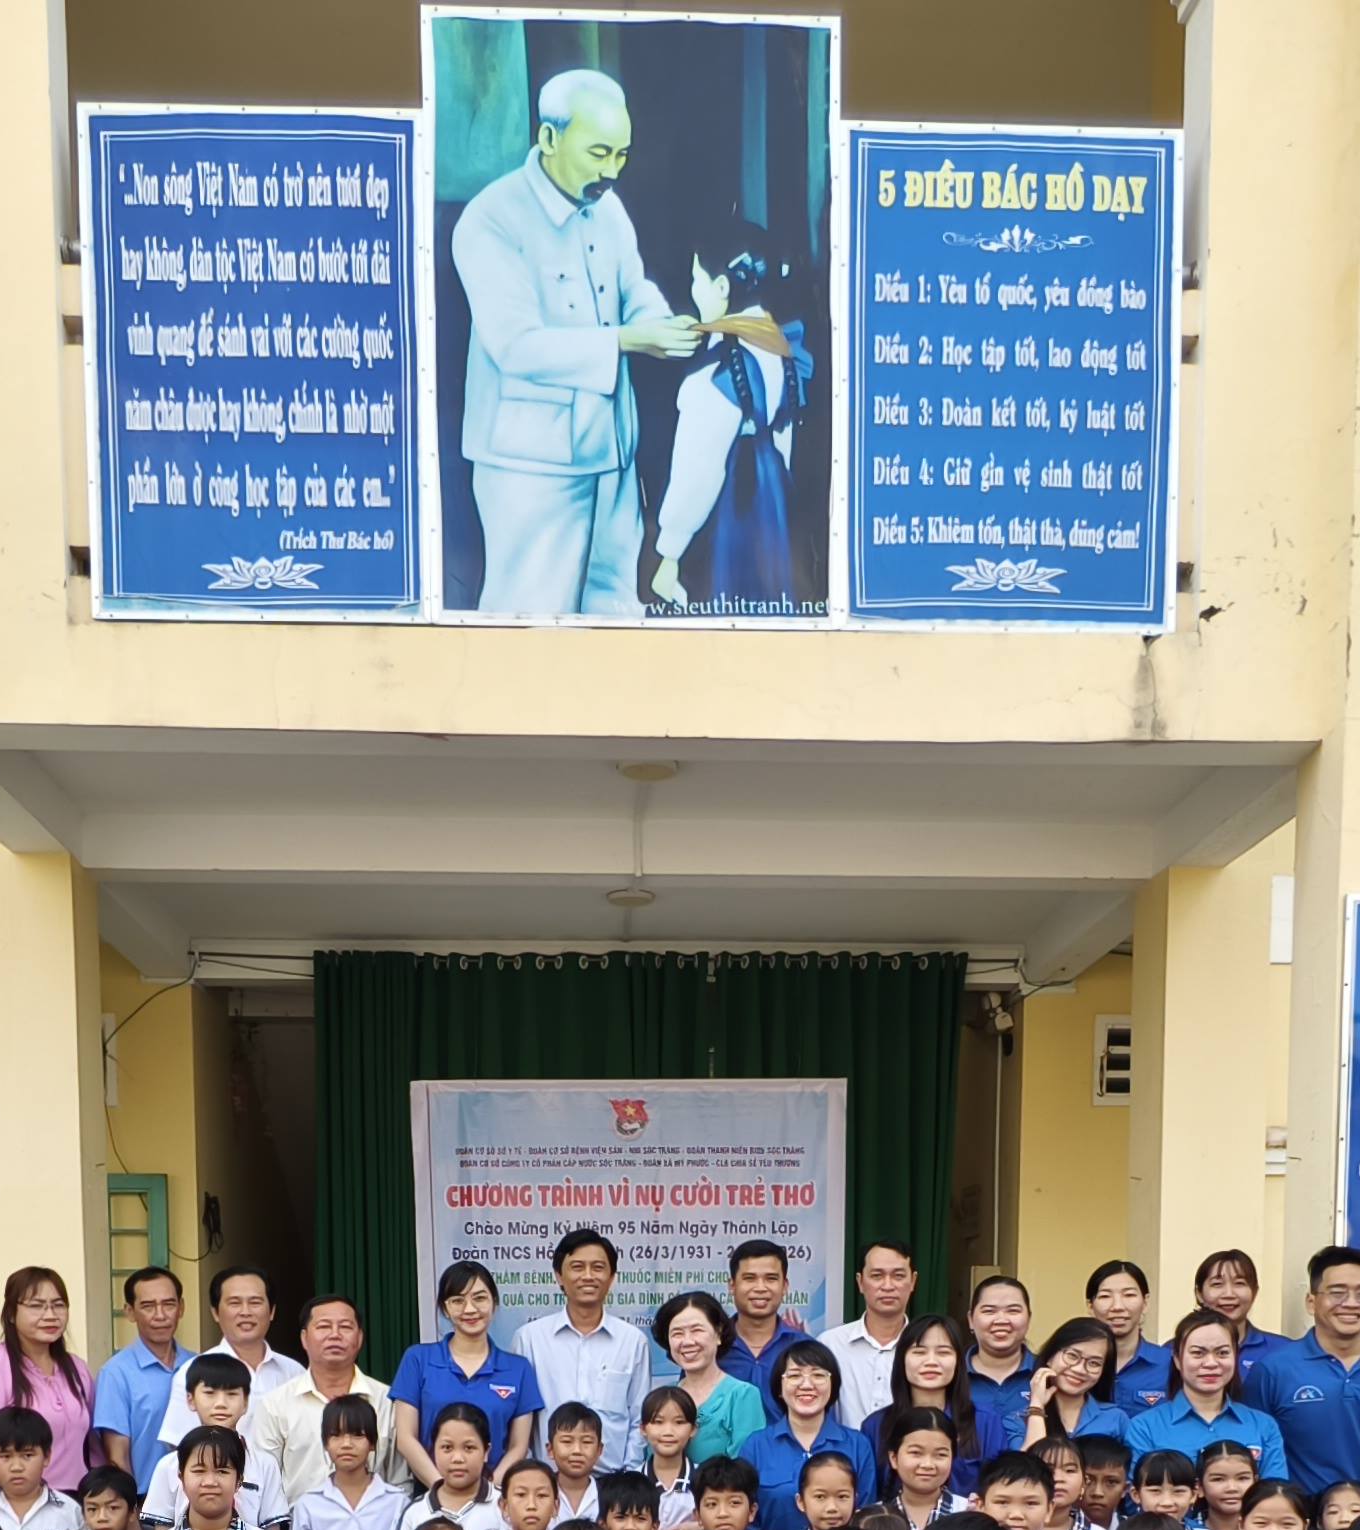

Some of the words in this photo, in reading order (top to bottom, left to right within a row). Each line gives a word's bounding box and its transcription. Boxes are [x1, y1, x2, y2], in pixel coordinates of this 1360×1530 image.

[164, 160, 193, 216] sông
[196, 161, 223, 218] Việt
[228, 163, 258, 206] Nam
[263, 160, 279, 207] có
[283, 161, 303, 207] trở
[308, 162, 332, 207] nên
[366, 163, 389, 221] đẹp
[878, 170, 896, 207] 5
[904, 158, 974, 209] ĐIỀU
[981, 162, 1037, 210] BÁC
[1045, 161, 1085, 212] HỒ
[1092, 175, 1147, 222] DẠY
[120, 235, 143, 291] hay
[190, 236, 213, 282] dân
[215, 237, 236, 295] tộc
[237, 237, 264, 294] Việt
[266, 238, 297, 282] Nam
[300, 237, 315, 282] có
[317, 236, 349, 283] bước
[371, 239, 390, 284] đài
[918, 274, 931, 303] 1:
[938, 273, 967, 304] Yêu
[997, 273, 1037, 312] quốc,
[1044, 277, 1070, 313] yêu
[1120, 279, 1147, 310] bào
[127, 311, 154, 355] vinh
[157, 319, 195, 366] quang
[217, 312, 248, 357] sánh
[251, 312, 270, 357] vai
[273, 312, 293, 358] với
[296, 312, 319, 358] các
[321, 313, 361, 369] cường
[363, 311, 394, 368] quốc
[918, 336, 933, 365] 2:
[942, 336, 972, 373] Học
[981, 336, 1005, 373] tập
[1015, 335, 1039, 372] tốt,
[1048, 337, 1072, 368] lao
[1081, 339, 1118, 376] động
[1126, 339, 1146, 371] tốt
[218, 387, 240, 442] hay
[325, 388, 339, 433] là
[343, 388, 368, 434] nhờ
[370, 390, 395, 446] một
[918, 397, 933, 426] 3:
[991, 395, 1016, 427] kết
[1026, 396, 1050, 433] tốt,
[1087, 400, 1116, 437] luật
[1125, 401, 1145, 431] tốt
[208, 463, 239, 517] công
[245, 463, 269, 519] học
[276, 462, 297, 519] tập
[304, 462, 327, 507] của
[334, 463, 356, 507] các
[919, 457, 933, 485] 4:
[981, 451, 1004, 492] gìn
[1014, 458, 1030, 494] vệ
[1041, 459, 1072, 488] sinh
[1082, 460, 1112, 496] thật
[1122, 460, 1142, 491] tốt
[347, 530, 372, 550] Bác
[910, 516, 924, 544] 5:
[927, 516, 974, 544] Khiêm
[978, 514, 1005, 549] tốn,
[1008, 517, 1037, 552] thật
[1040, 517, 1066, 551] thà,
[446, 1182, 532, 1208] CHƯƠNG
[538, 1177, 604, 1207] TRÌNH
[608, 1177, 630, 1207] VÌ
[636, 1184, 664, 1213] NỤ
[670, 1175, 720, 1207] CƯỜI
[725, 1176, 766, 1207] TRẺ
[771, 1181, 815, 1207] THƠ
[464, 1221, 502, 1235] Chào
[508, 1220, 548, 1238] Mừng
[619, 1223, 636, 1234] 95
[641, 1220, 674, 1235] Năm
[679, 1220, 718, 1238] Ngày
[722, 1220, 767, 1235] Thành
[771, 1222, 798, 1238] Lập
[452, 1245, 489, 1261] Đoàn
[493, 1247, 531, 1260] TNCS
[629, 1245, 712, 1262] (26/3/1931
[528, 1293, 549, 1305] CHO
[617, 1293, 636, 1305] GIA
